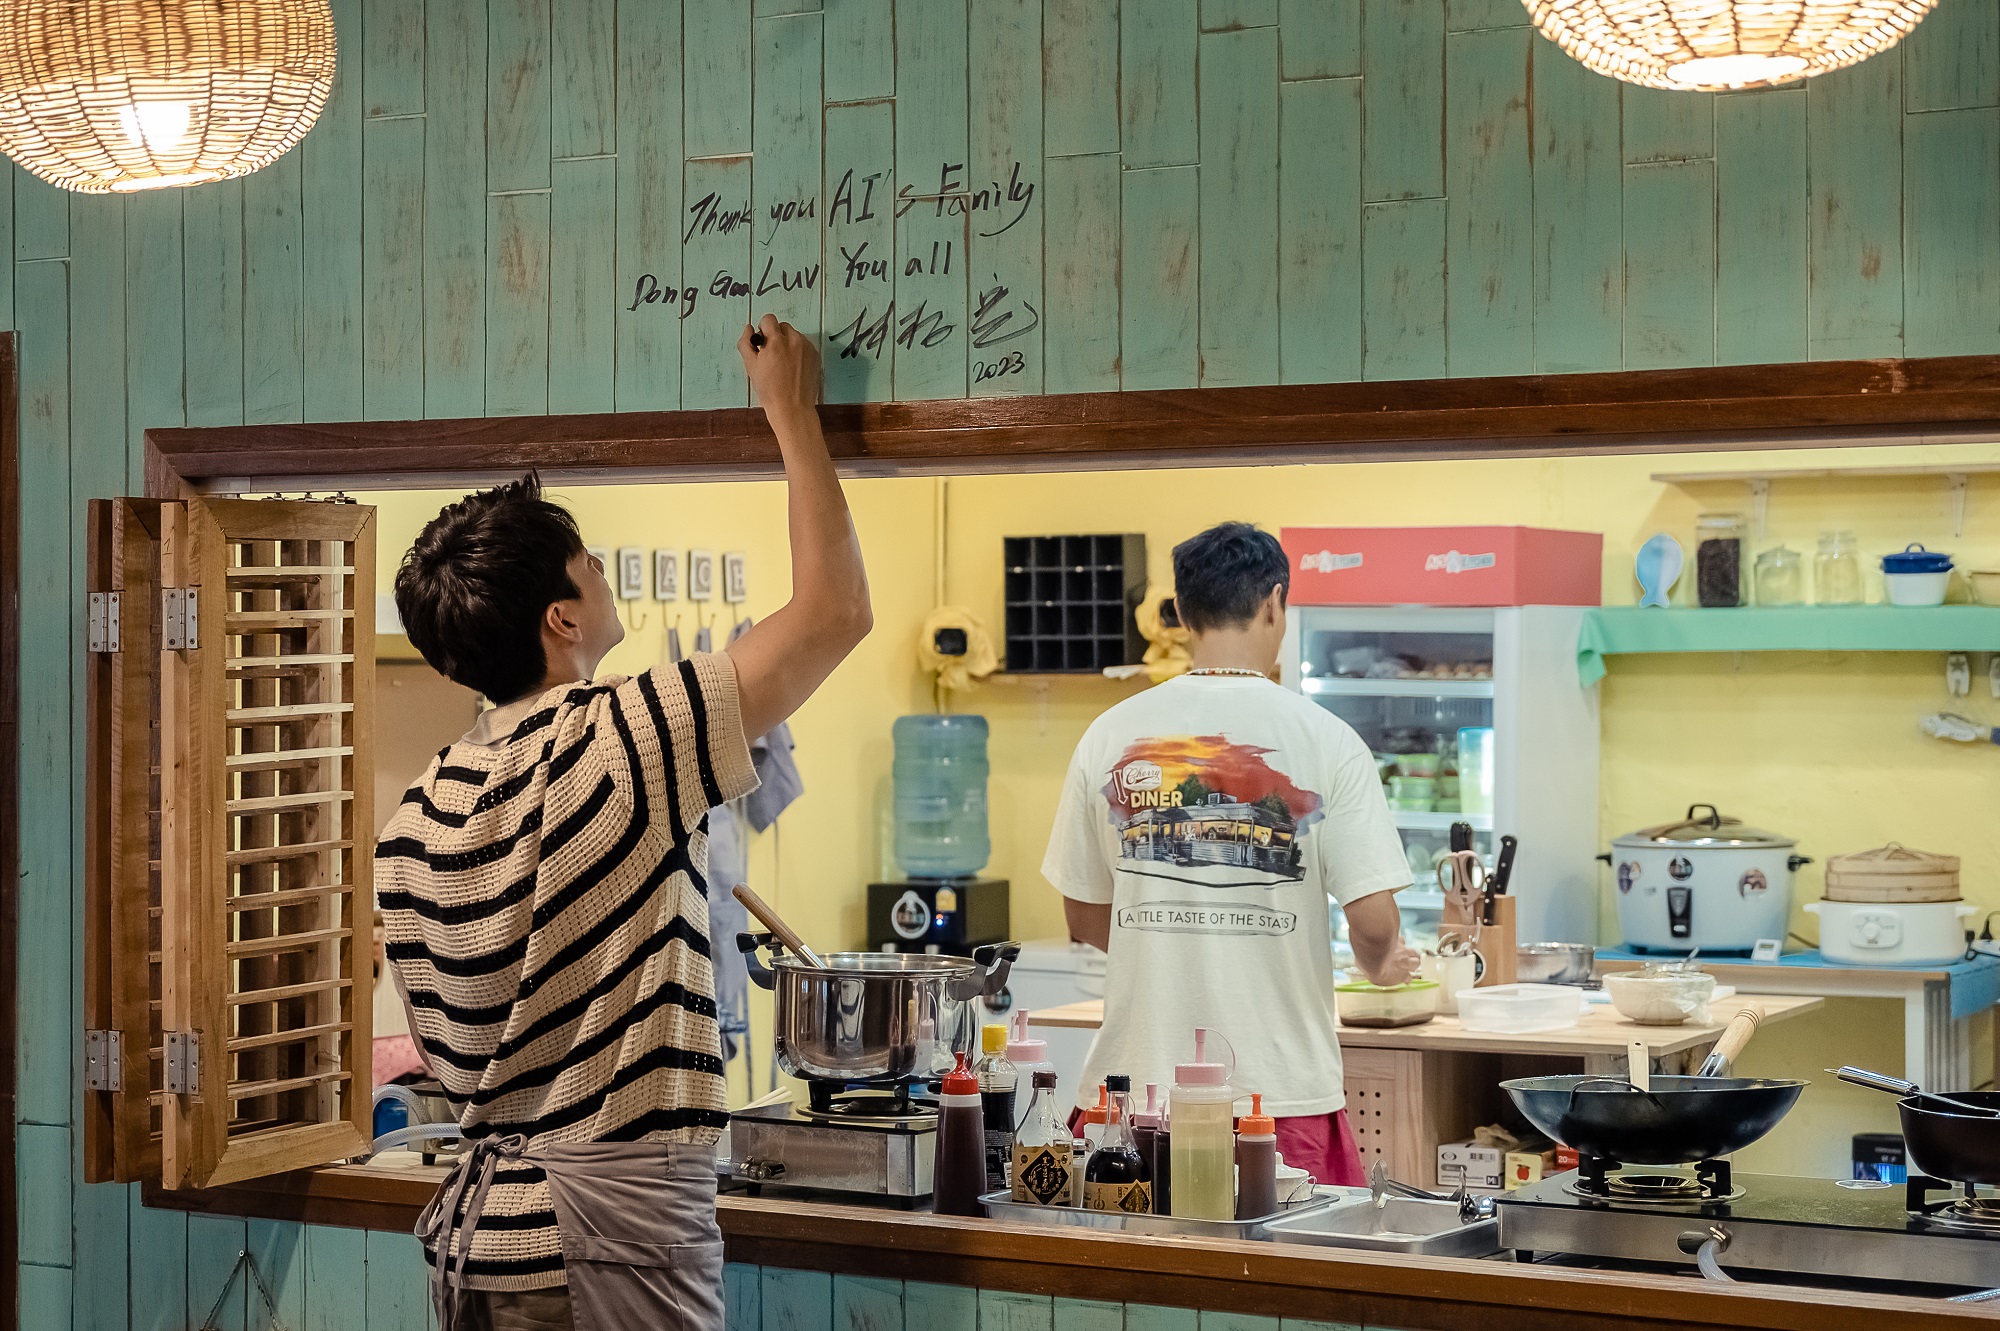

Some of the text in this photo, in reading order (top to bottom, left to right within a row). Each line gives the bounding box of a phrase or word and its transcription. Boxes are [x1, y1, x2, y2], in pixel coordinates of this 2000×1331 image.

[684, 191, 756, 245] Thank
[758, 197, 815, 246] you
[626, 274, 699, 319] Dong
[756, 256, 820, 297] Luv
[840, 241, 888, 288] You
[904, 240, 952, 276] all
[972, 351, 1026, 384] 2023
[1130, 790, 1184, 809] DINER
[1125, 912, 1135, 924] A
[1167, 911, 1206, 925] TASTE
[1209, 912, 1225, 925] OF
[1229, 913, 1253, 926] THE
